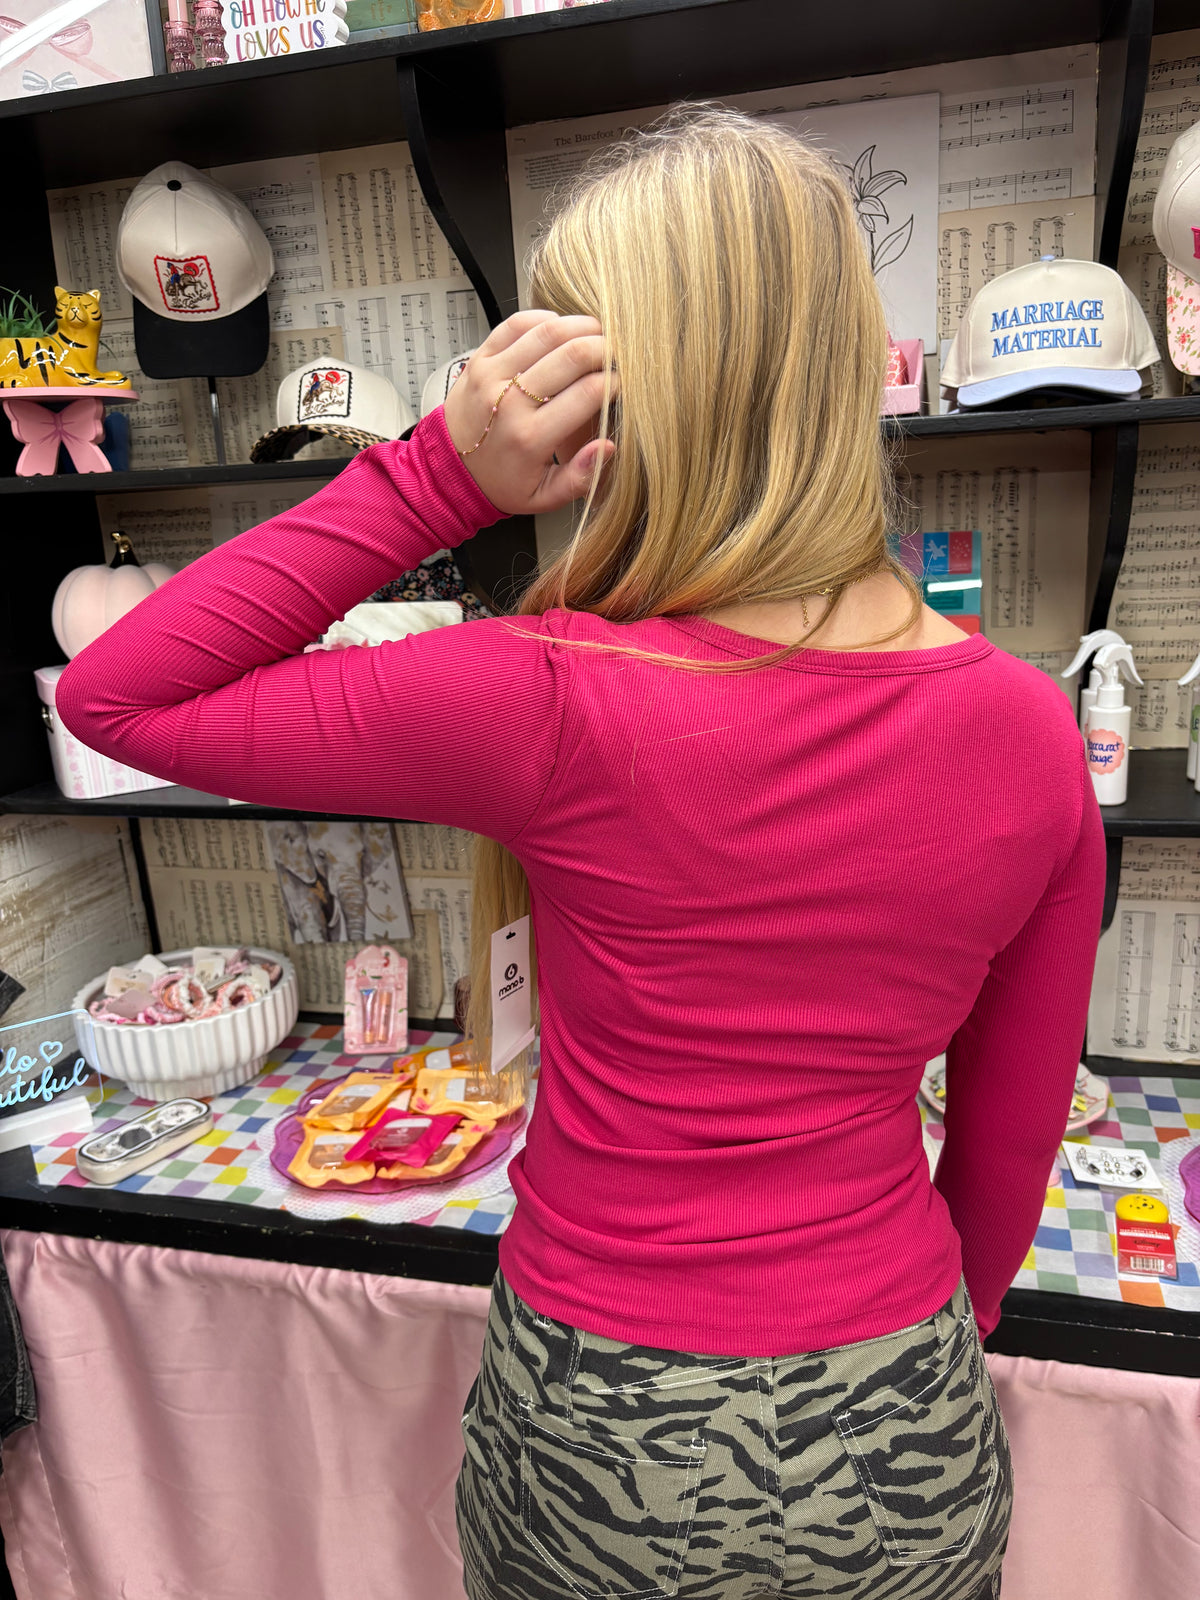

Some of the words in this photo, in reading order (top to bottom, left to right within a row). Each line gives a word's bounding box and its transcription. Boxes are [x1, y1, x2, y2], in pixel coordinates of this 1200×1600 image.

[229, 0, 256, 29] OH
[262, 0, 300, 23] HOW
[554, 137, 572, 147] The
[575, 130, 614, 143] Barefoot
[990, 299, 1104, 332] MARRIAGE
[992, 327, 1102, 357] MATERIAL
[499, 980, 518, 997] mono
[519, 976, 525, 984] b
